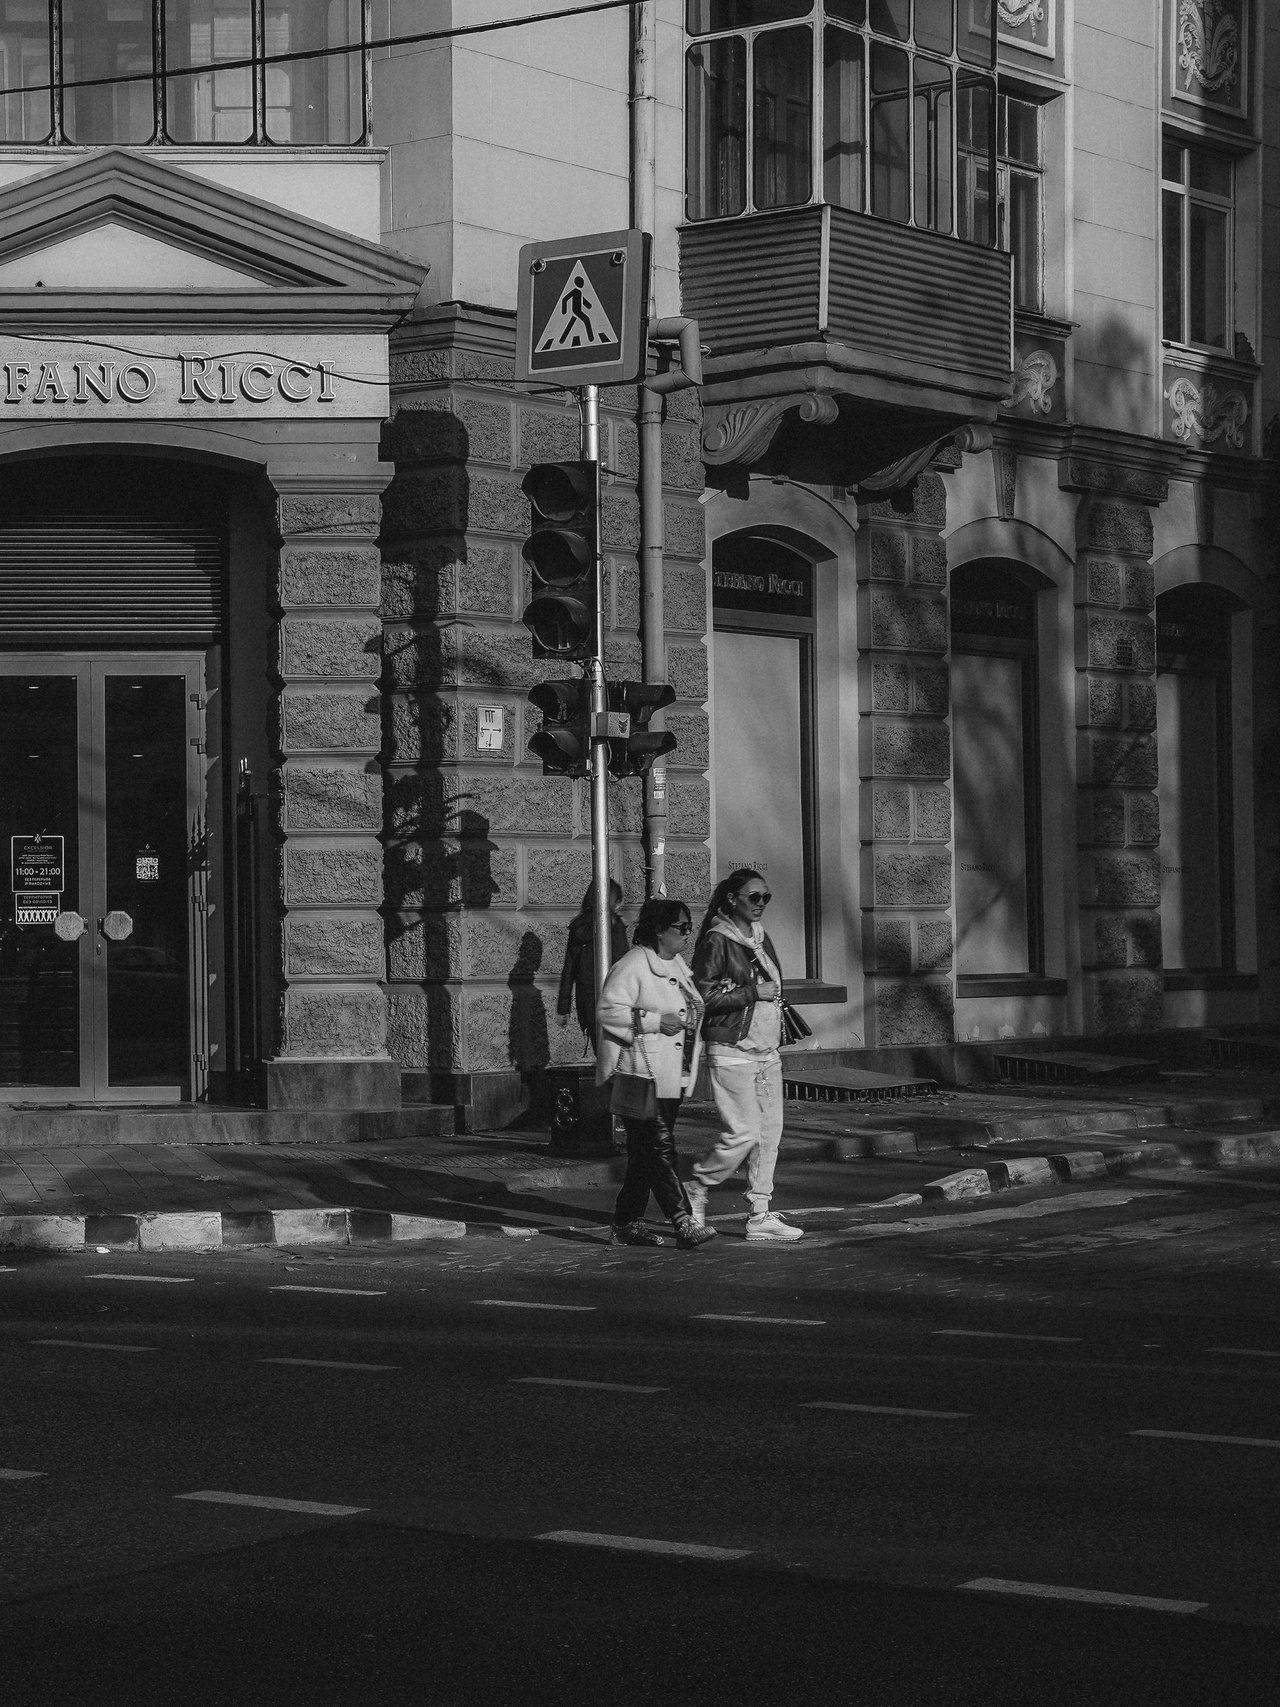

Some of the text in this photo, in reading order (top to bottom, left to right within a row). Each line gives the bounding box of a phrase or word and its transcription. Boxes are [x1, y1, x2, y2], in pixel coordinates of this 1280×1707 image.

[178, 349, 338, 403] RICCI
[768, 573, 804, 597] RICCI
[727, 861, 752, 870] STEFANO
[960, 862, 982, 871] STEFANO
[15, 868, 34, 876] 11:00
[39, 868, 61, 876] 21:00
